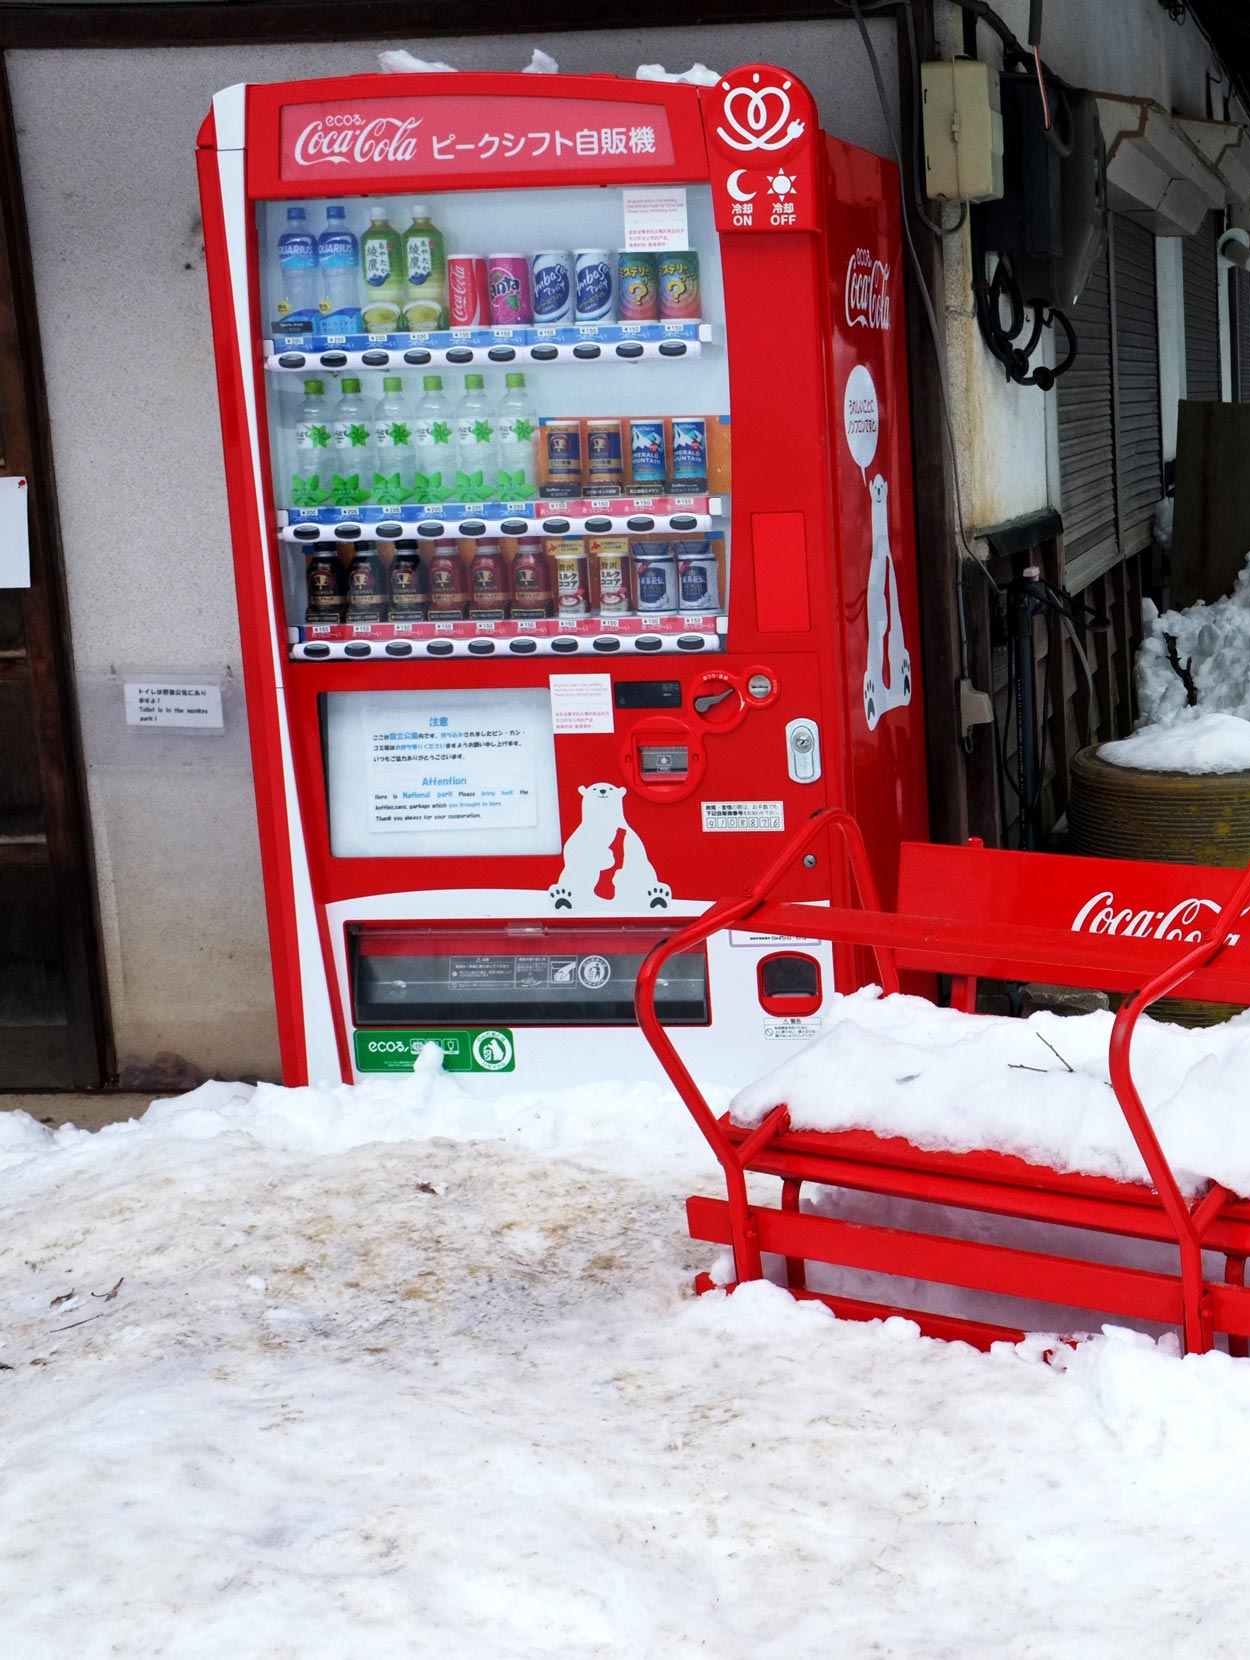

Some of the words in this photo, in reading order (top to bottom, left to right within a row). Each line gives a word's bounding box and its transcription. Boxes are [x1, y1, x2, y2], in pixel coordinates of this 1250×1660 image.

[294, 116, 424, 166] Coca-Cola
[432, 126, 656, 160] ピークシフト自販機
[732, 203, 753, 214] 冷却
[772, 202, 794, 213] 冷却
[733, 215, 752, 226] ON
[770, 214, 796, 226] OFF
[450, 264, 468, 321] Coca-Cola
[845, 254, 890, 330] Coca-Cola
[430, 717, 448, 726] 注意
[422, 776, 467, 786] Attention
